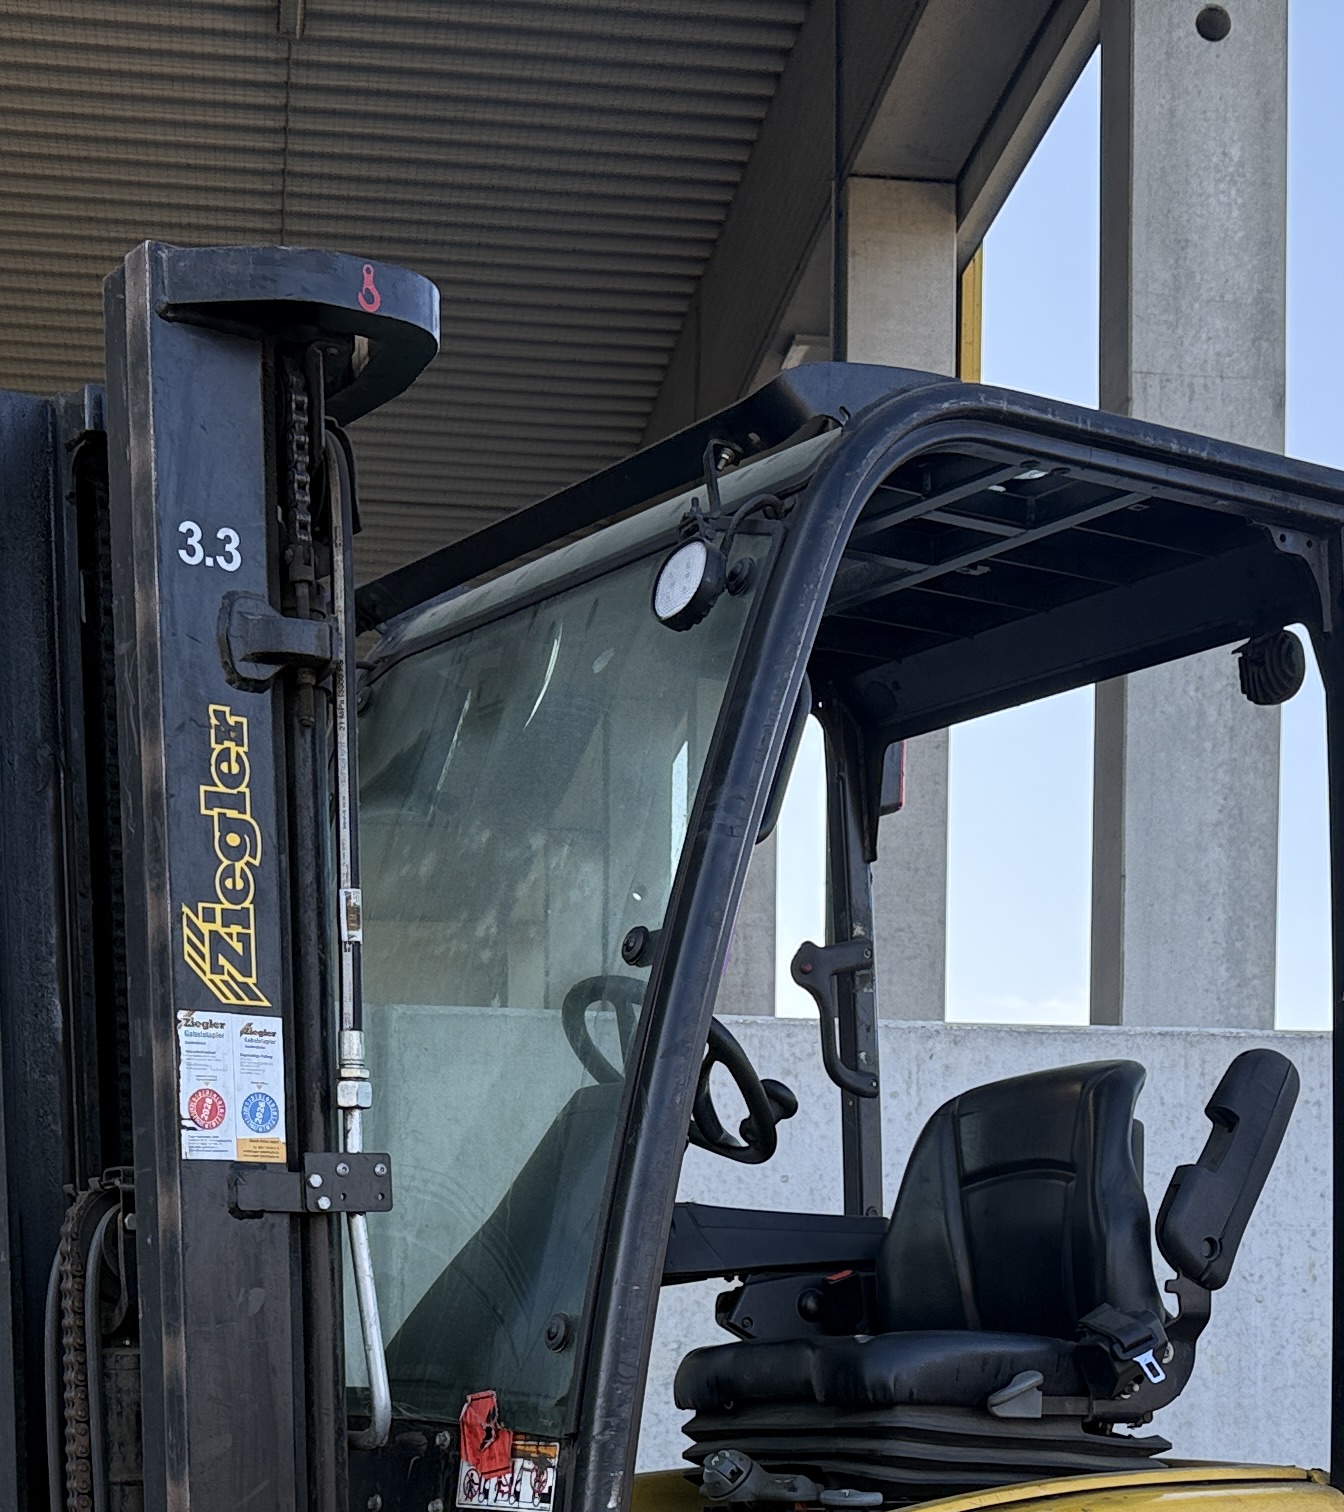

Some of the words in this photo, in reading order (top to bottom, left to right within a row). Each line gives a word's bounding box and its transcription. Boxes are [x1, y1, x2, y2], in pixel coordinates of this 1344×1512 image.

[177, 520, 243, 573] 3.3
[196, 703, 265, 988] Ziegler
[183, 1017, 226, 1029] Ziegler
[242, 1025, 277, 1038] Ziegler
